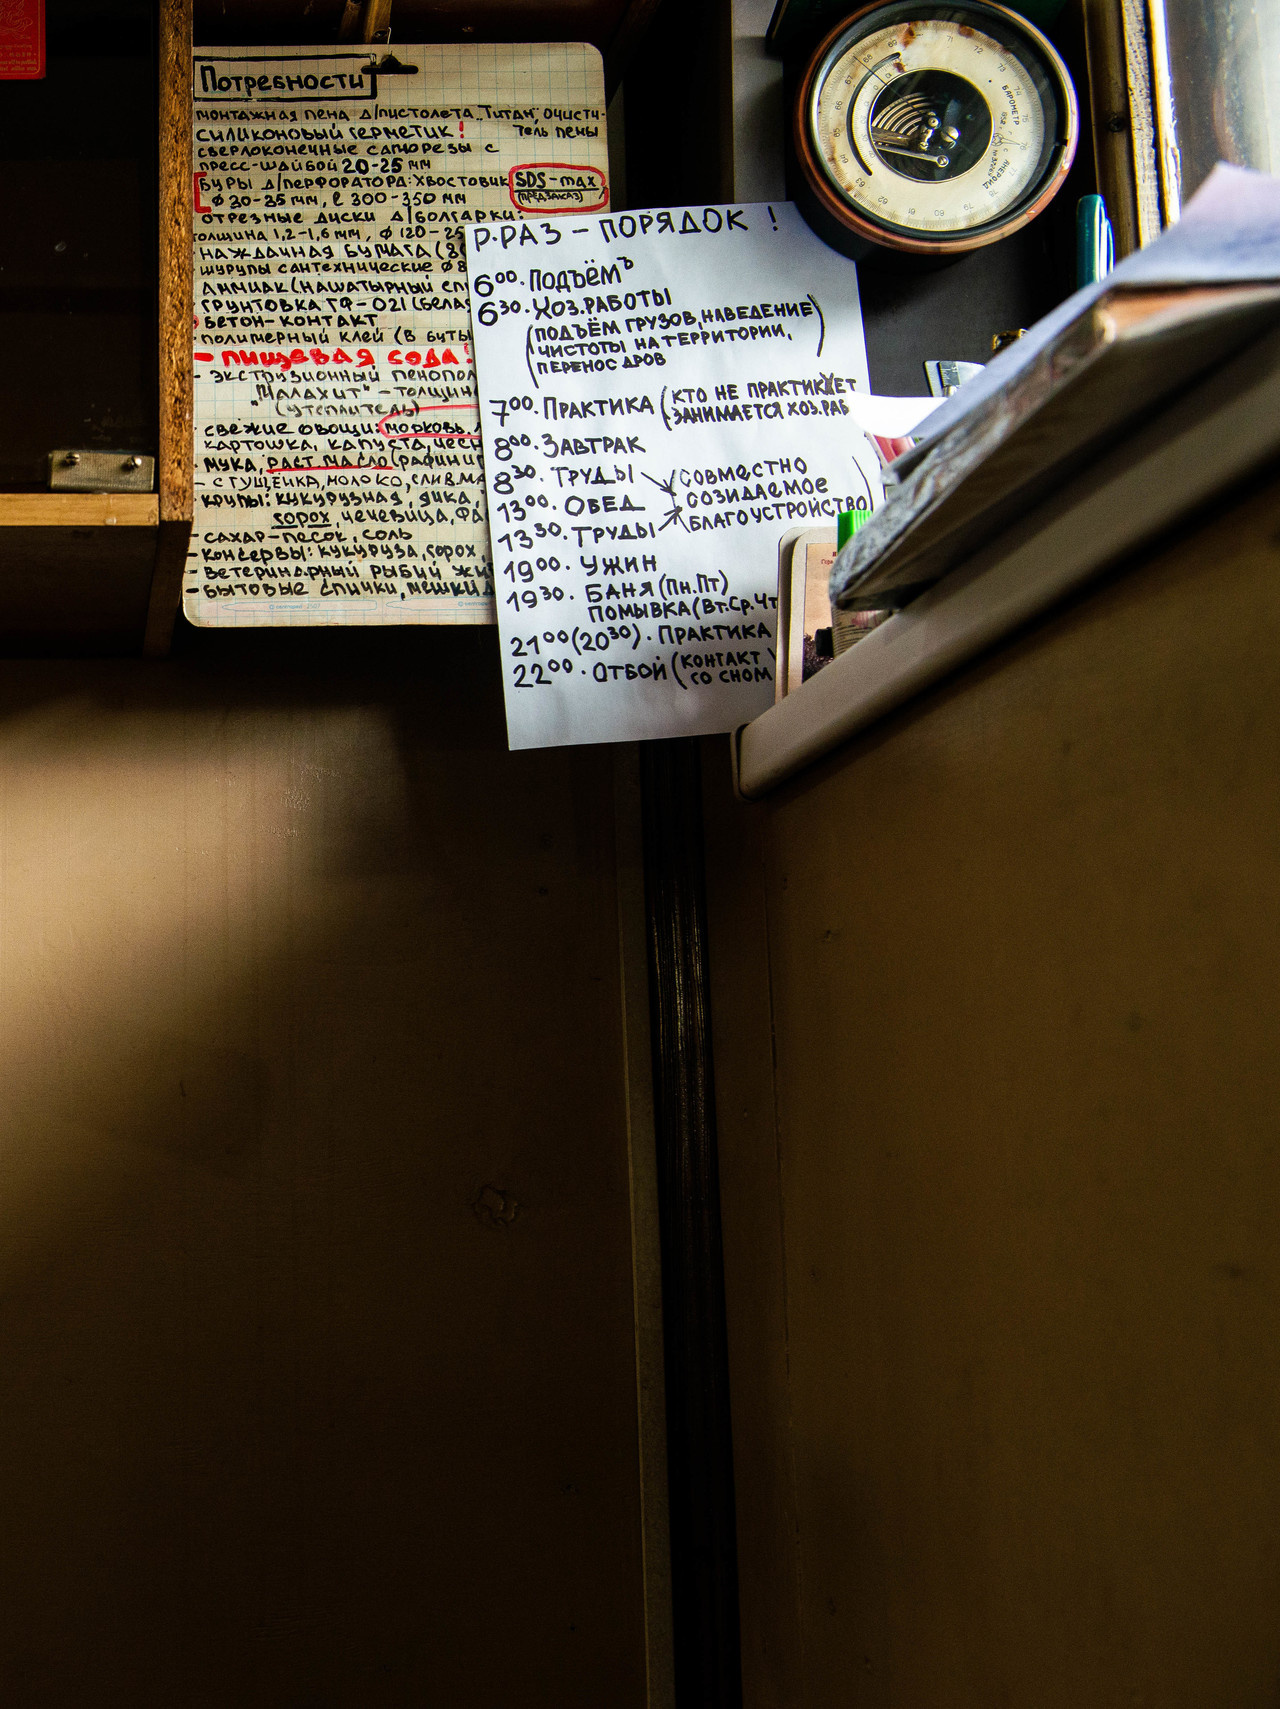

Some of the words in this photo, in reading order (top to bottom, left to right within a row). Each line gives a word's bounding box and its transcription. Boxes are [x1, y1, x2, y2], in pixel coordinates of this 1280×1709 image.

[200, 65, 364, 97] Потребности
[1001, 84, 1020, 126] БАРОМЕТР
[196, 109, 298, 122] монтажная
[305, 109, 351, 121] пена
[196, 123, 344, 142] силиконовый
[555, 125, 598, 138] пены
[198, 144, 358, 158] сверлоконечные
[367, 143, 472, 158] саморезы
[342, 158, 403, 174] 20-25
[599, 208, 749, 243] ПОРЯДОК
[201, 328, 329, 345] полимерный
[340, 327, 384, 343] клей
[538, 340, 627, 358] ЧИСТОТЫ
[537, 358, 618, 375] ПЕРЕНОС
[622, 352, 667, 369] ДРОВ
[210, 365, 380, 385] экструзионный
[715, 384, 739, 401] НЕ
[204, 421, 295, 437] свежие
[362, 528, 413, 540] соль
[370, 561, 441, 580] рыбий
[580, 554, 658, 577] УЖИН
[204, 582, 309, 599] бытовые
